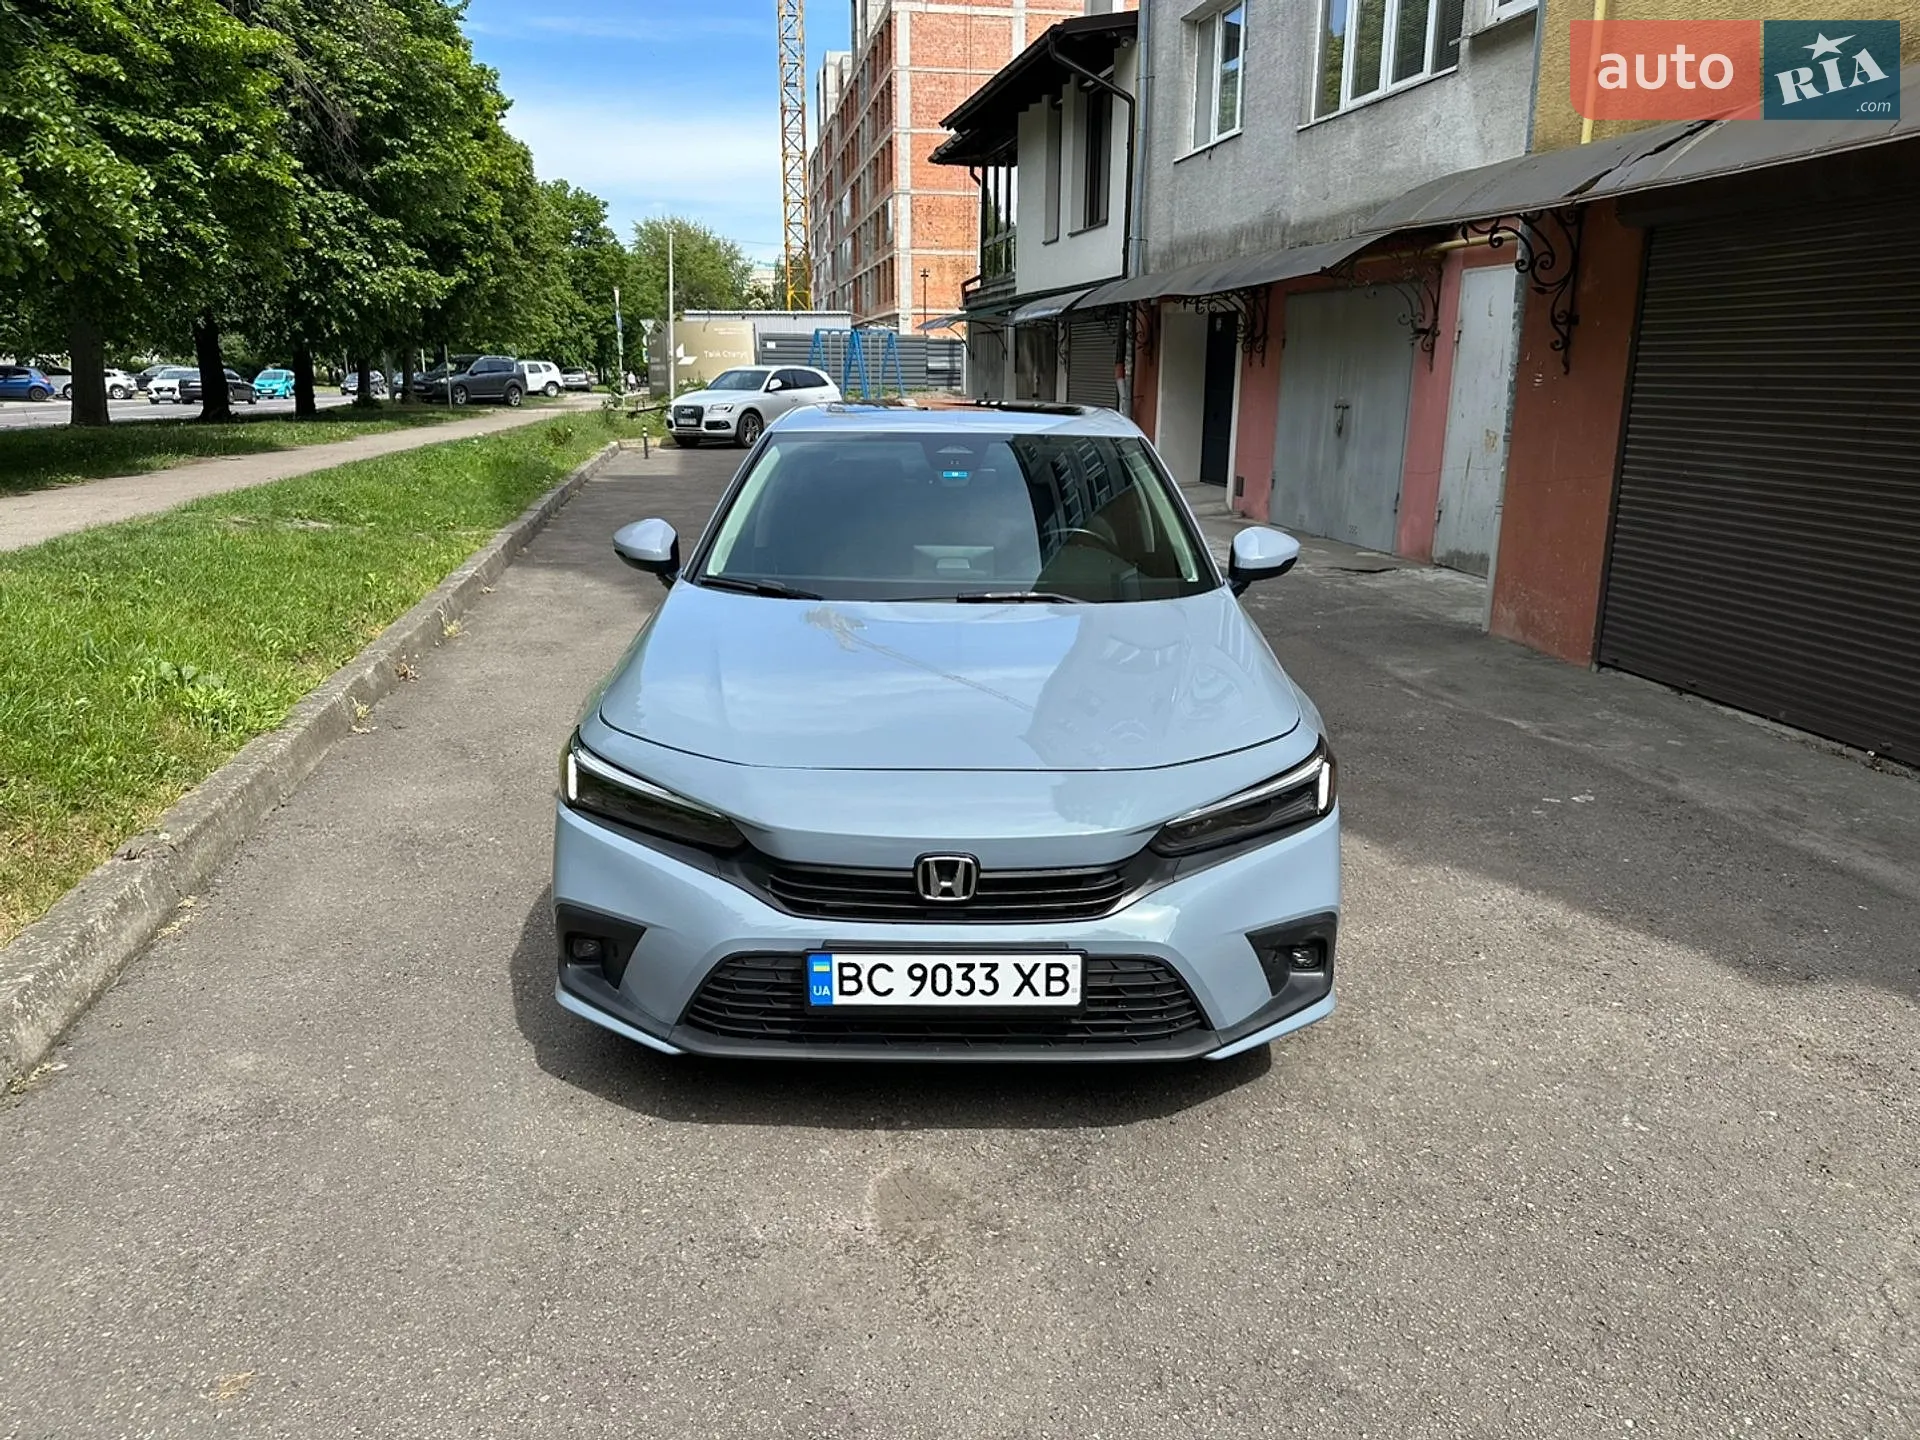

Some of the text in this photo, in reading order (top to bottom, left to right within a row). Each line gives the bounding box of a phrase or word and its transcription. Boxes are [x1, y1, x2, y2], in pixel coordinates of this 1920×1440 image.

[837, 962, 1070, 997] BC 9033 XB
[813, 986, 831, 996] UA
